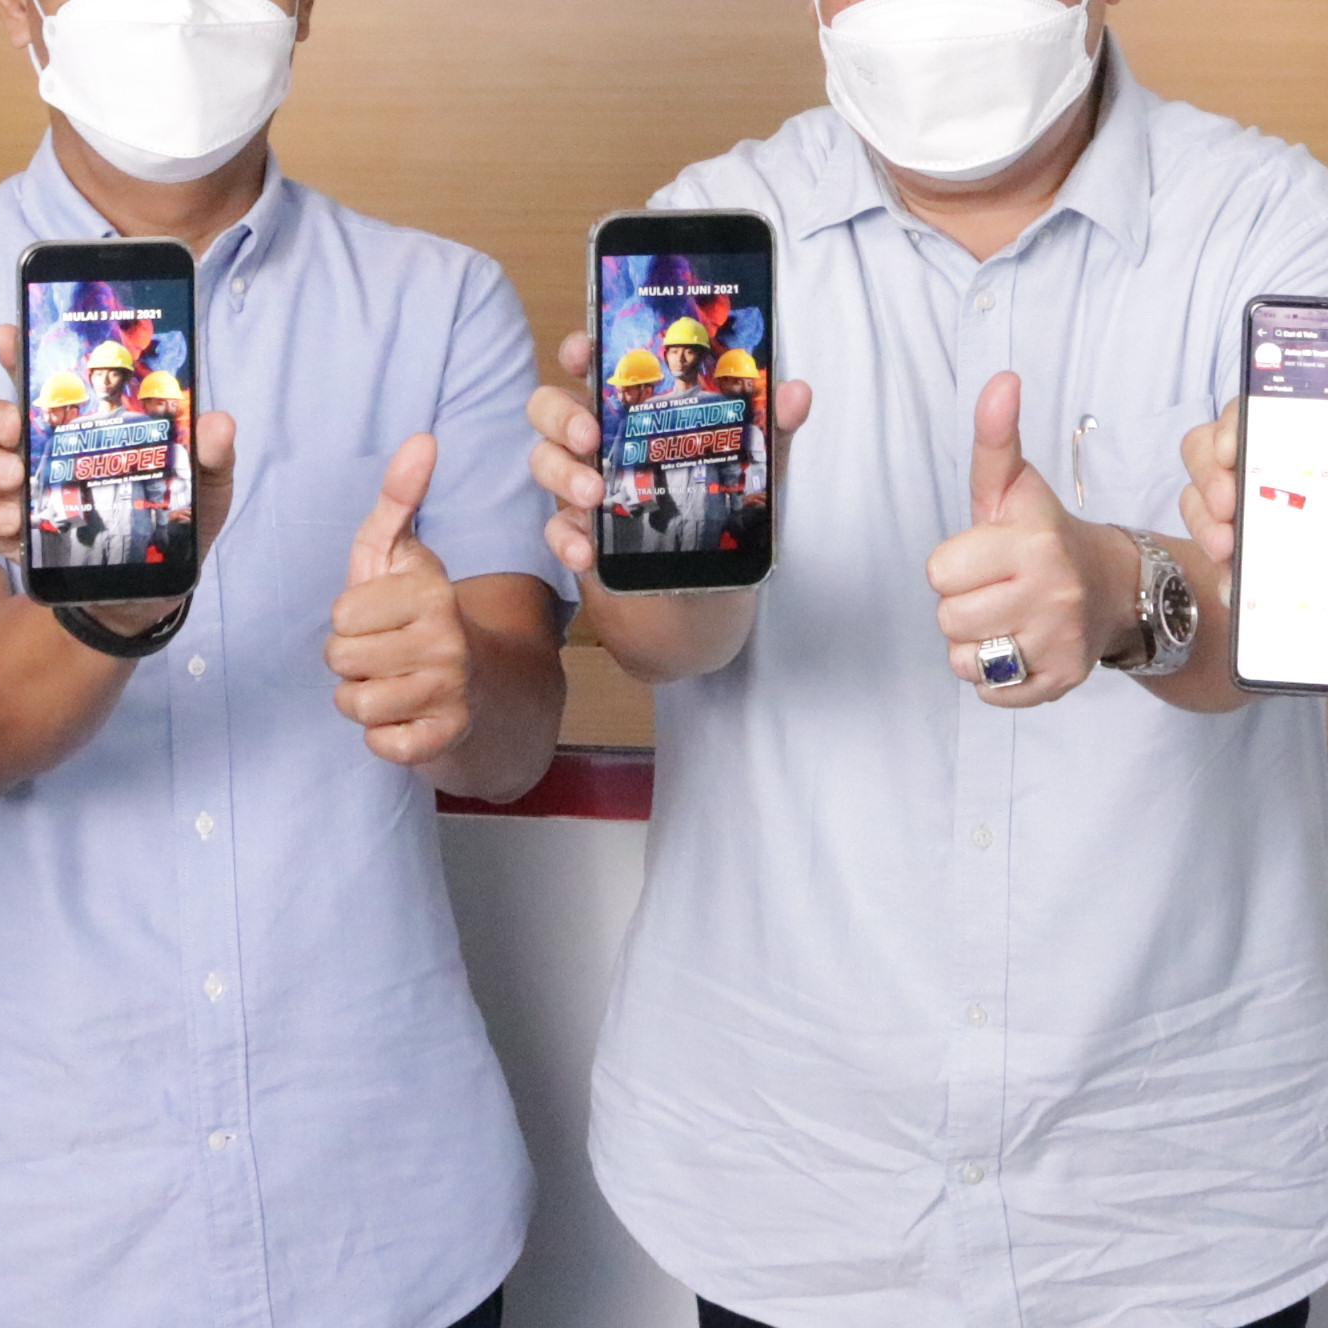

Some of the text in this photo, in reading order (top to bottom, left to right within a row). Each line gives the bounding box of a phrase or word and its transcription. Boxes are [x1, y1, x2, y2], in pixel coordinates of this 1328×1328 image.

[638, 284, 739, 296] MULAI 3 JUNI 2021
[62, 309, 162, 321] MULAI 3 JUNI 2021
[629, 397, 699, 412] ASTRA UD TRUCKS
[55, 417, 123, 432] ASTRA UD TRUCKS
[625, 400, 745, 438] KINI HADIR
[52, 419, 170, 457] KINI HADIR
[622, 427, 743, 465] DI SHOPEE
[49, 445, 168, 483] DI SHOPEE
